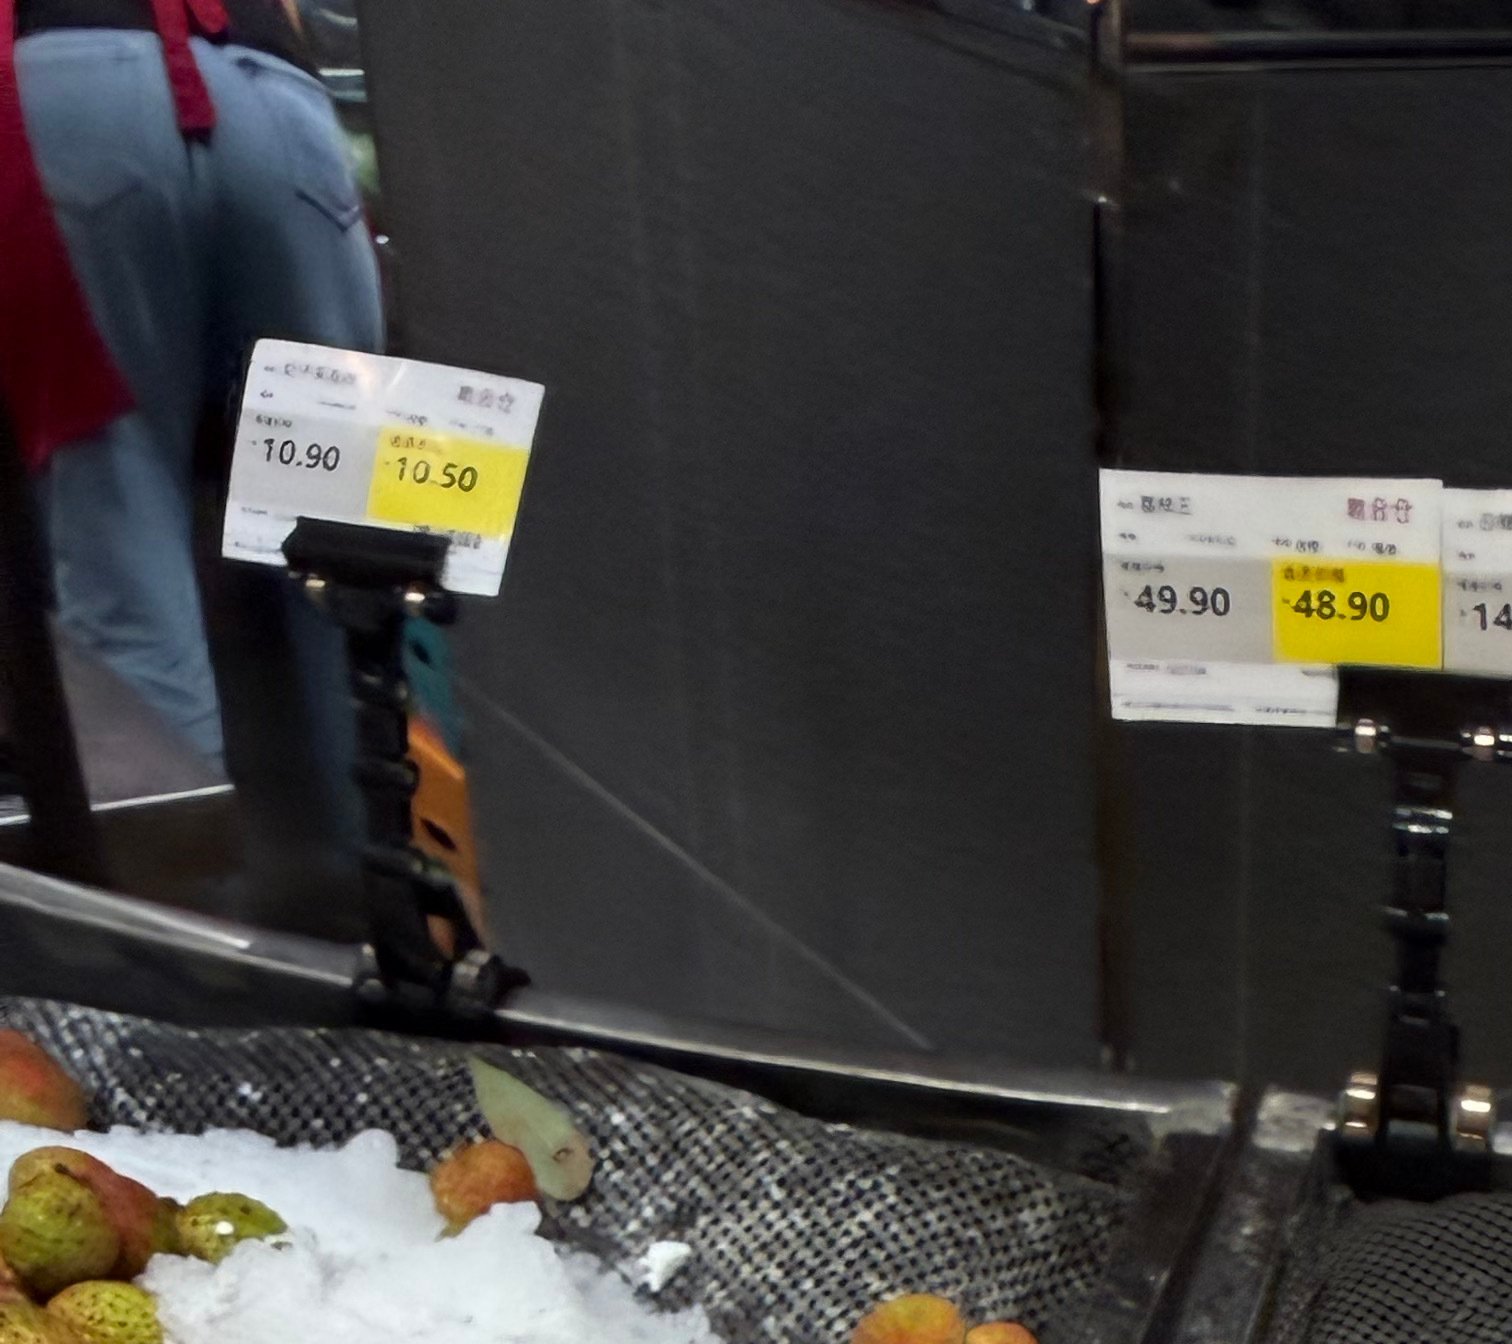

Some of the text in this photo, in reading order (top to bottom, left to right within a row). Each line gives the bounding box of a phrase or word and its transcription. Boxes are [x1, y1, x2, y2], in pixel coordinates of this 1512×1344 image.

[262, 438, 341, 472] 10.90
[1134, 585, 1231, 616] 49.90
[1292, 589, 1390, 622] 48.90
